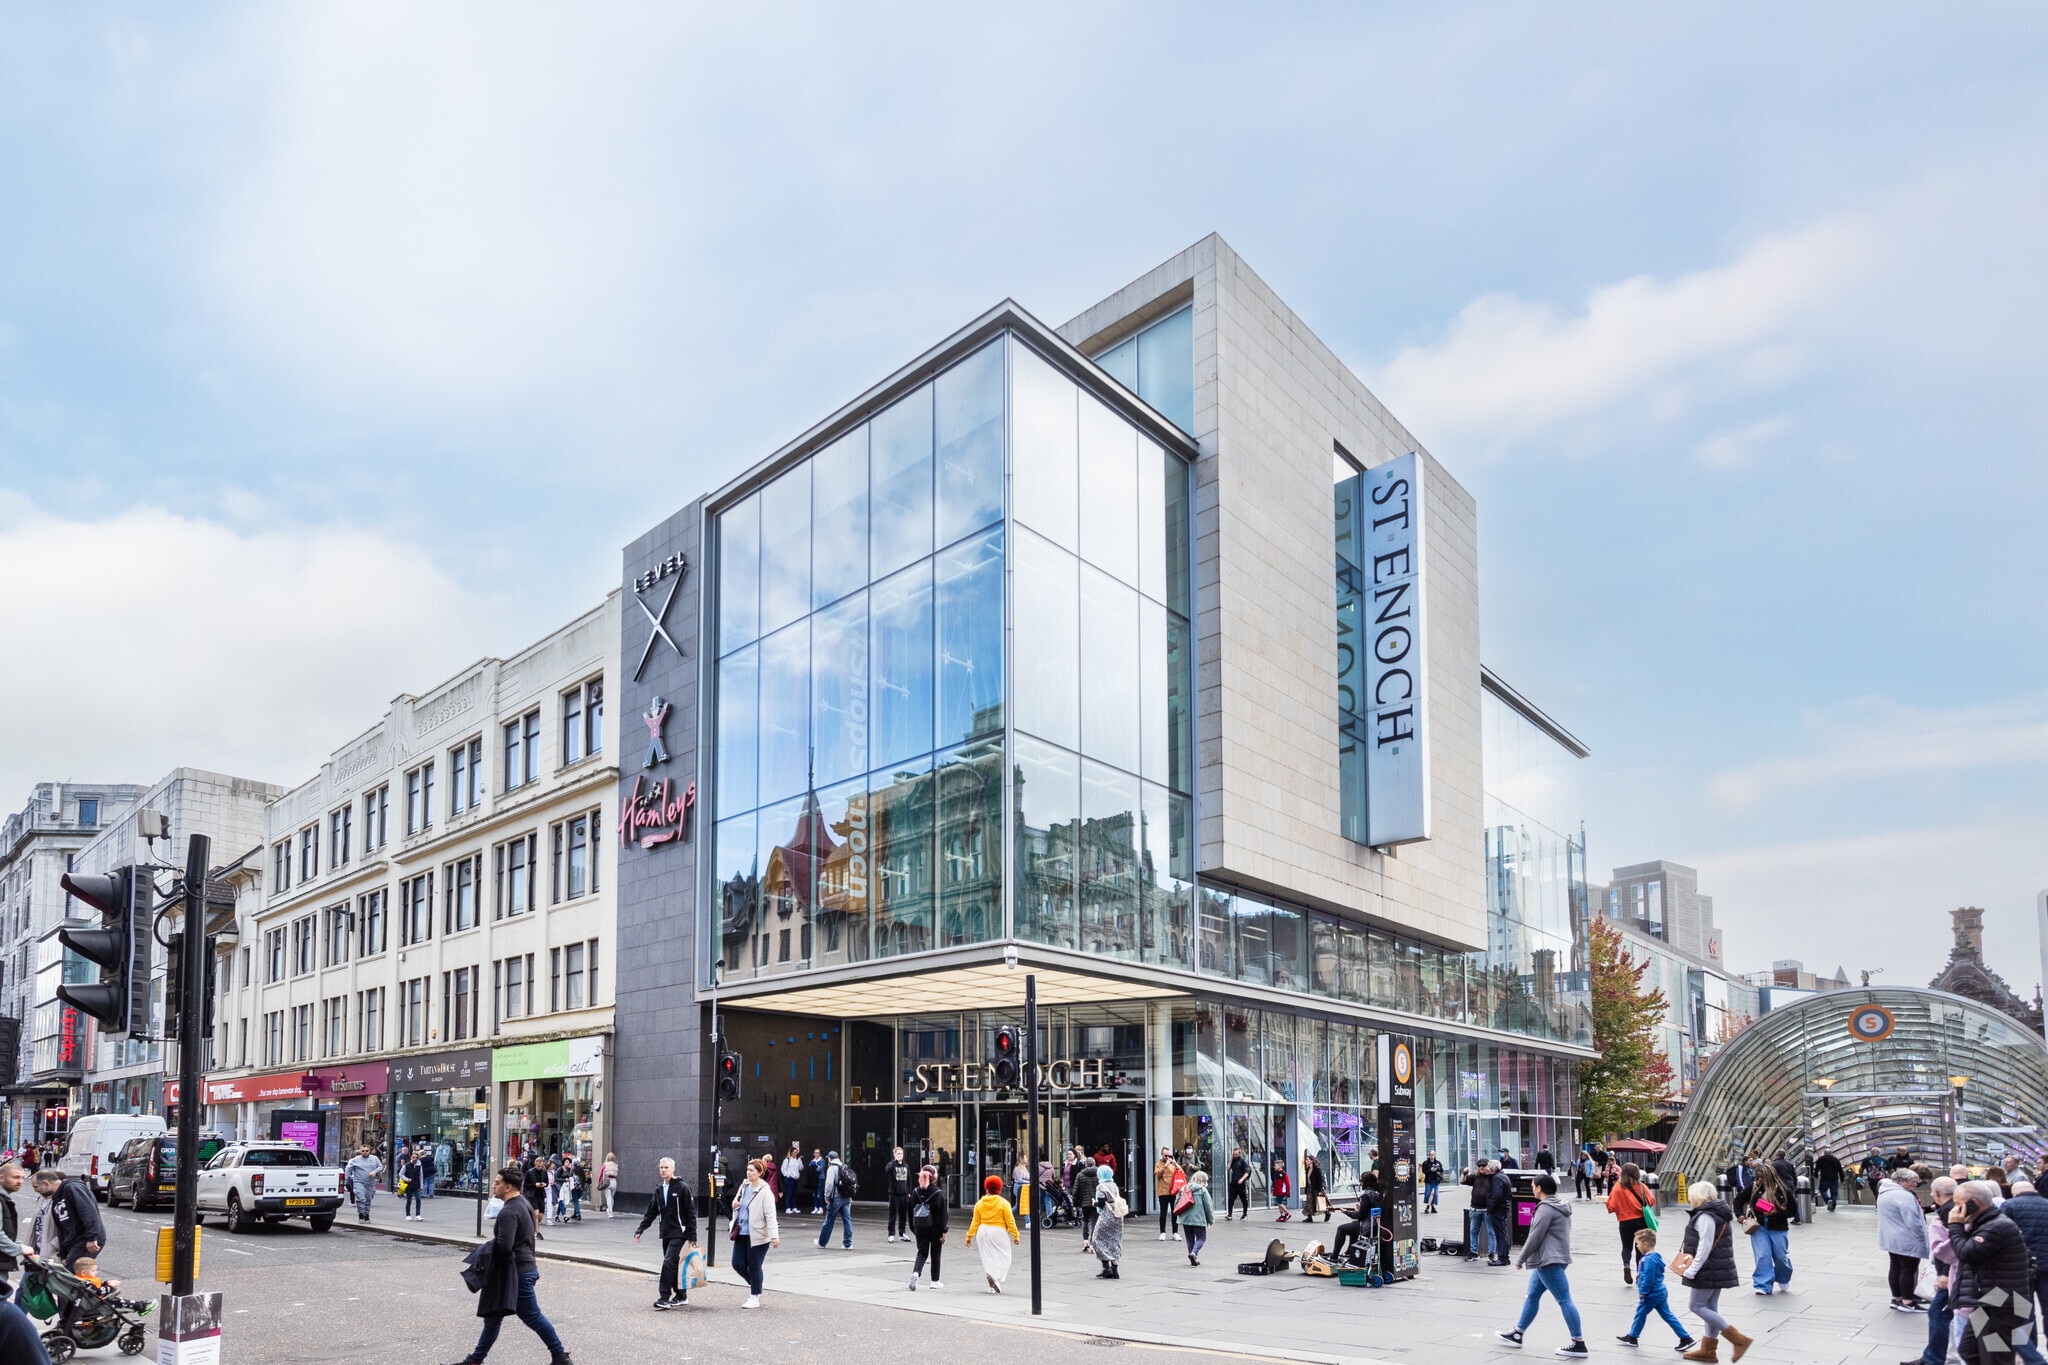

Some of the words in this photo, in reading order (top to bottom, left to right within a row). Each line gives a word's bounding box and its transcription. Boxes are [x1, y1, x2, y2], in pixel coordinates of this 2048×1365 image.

[1371, 478, 1409, 532] ST
[633, 550, 685, 593] LEVEL
[1373, 543, 1414, 749] ENOCH
[616, 775, 695, 848] Hamleys
[570, 1056, 590, 1073] out
[915, 1063, 950, 1093] ST
[1394, 1085, 1412, 1099] Subway
